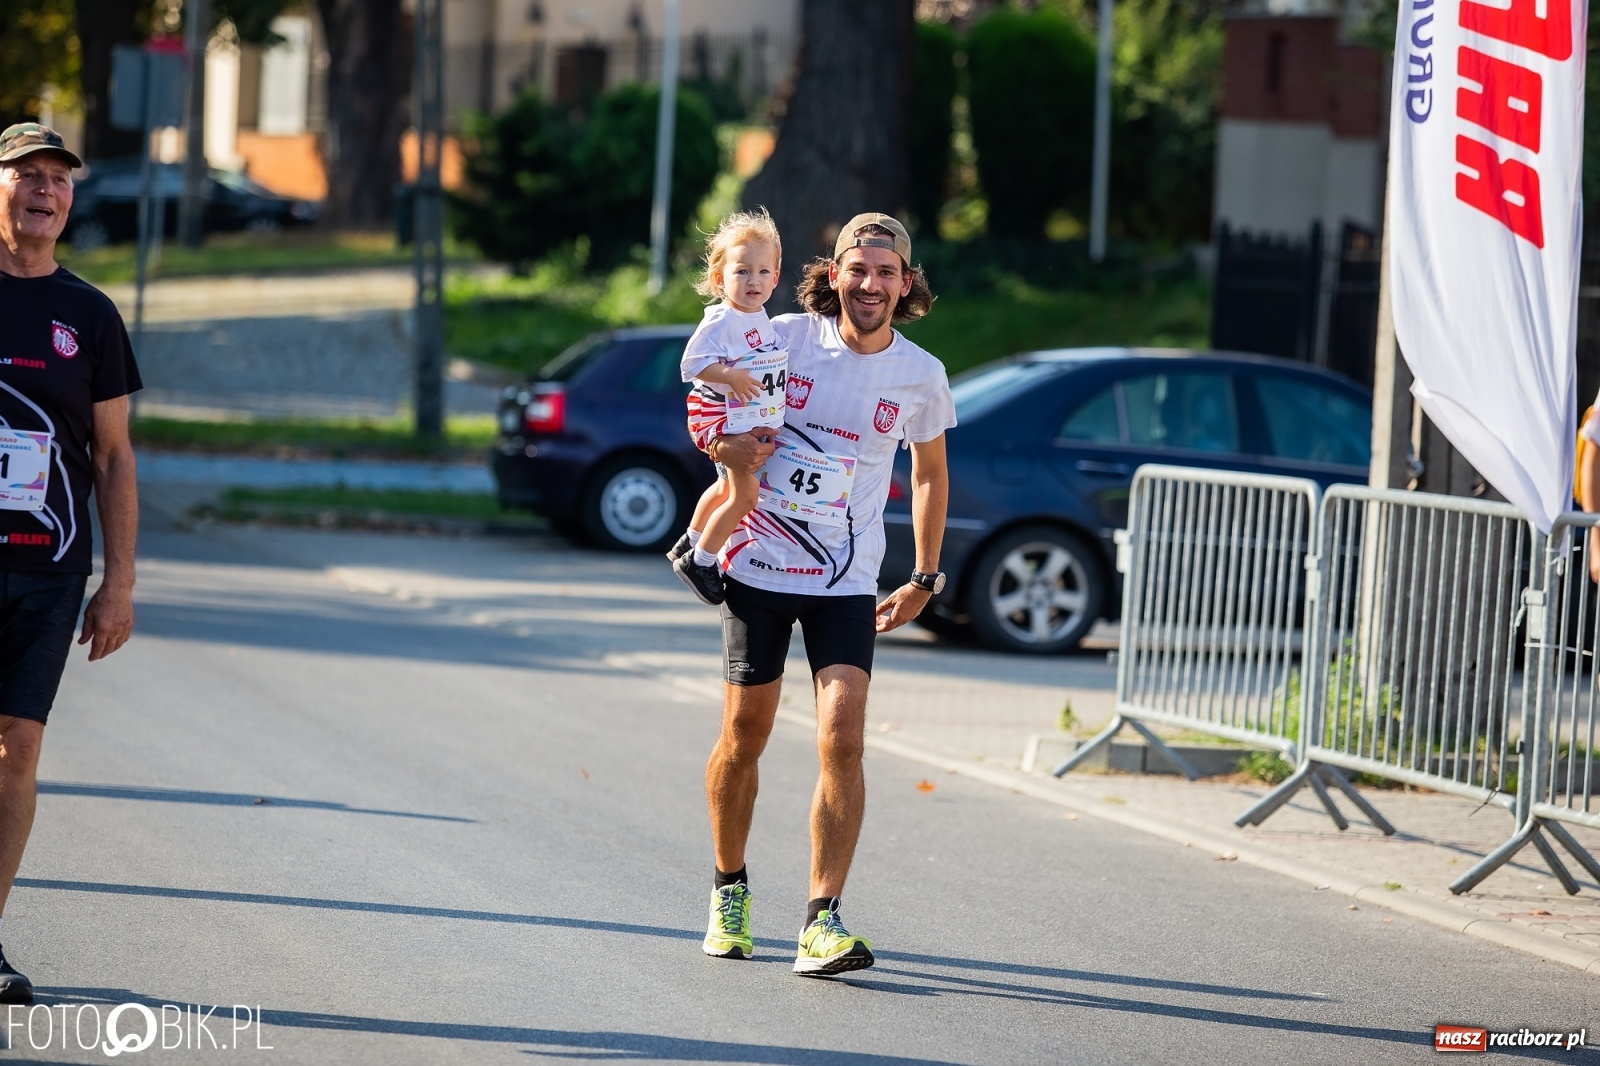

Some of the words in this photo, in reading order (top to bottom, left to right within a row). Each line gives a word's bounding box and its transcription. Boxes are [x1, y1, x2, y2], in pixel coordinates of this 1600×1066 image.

[760, 369, 787, 397] 44
[789, 371, 815, 383] POLSKA
[789, 468, 822, 496] 45
